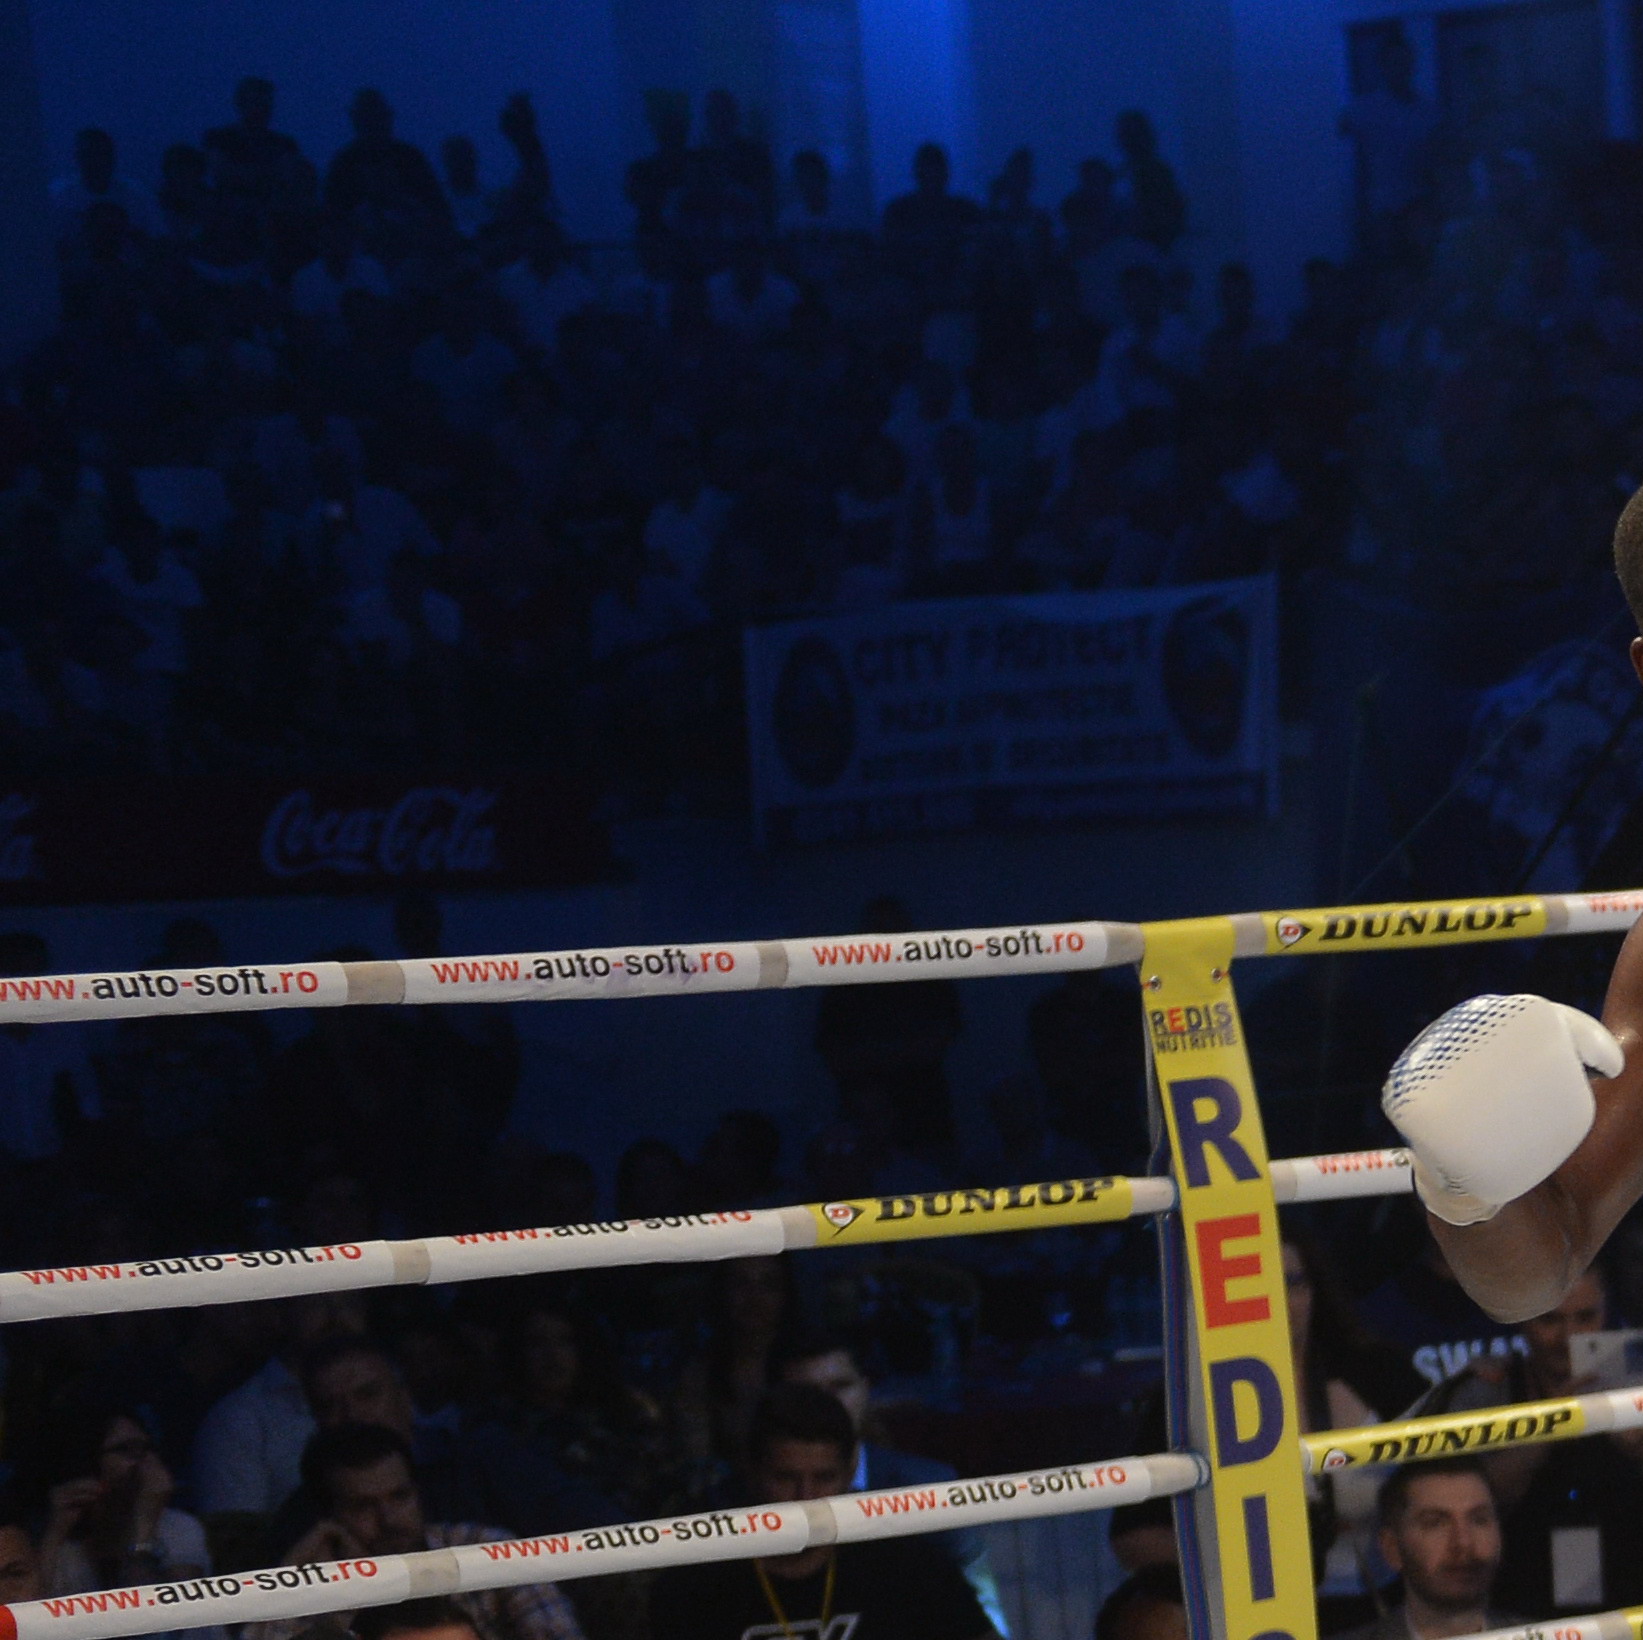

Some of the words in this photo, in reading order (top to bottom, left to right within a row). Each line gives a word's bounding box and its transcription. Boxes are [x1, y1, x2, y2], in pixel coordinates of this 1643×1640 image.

[1319, 905, 1532, 942] DUNLOP
[431, 947, 735, 985] www.auto-soft.ro
[813, 930, 1084, 968] www.auto-soft.ro
[1151, 1001, 1233, 1036] REDIS
[875, 1177, 1115, 1223] DUNLOP
[1365, 1407, 1577, 1468] DUNLOP
[857, 1464, 1128, 1518] www.auto-soft.ro
[480, 1508, 783, 1563] www.auto-soft.ro
[43, 1557, 380, 1619] www.auto-soft.ro
